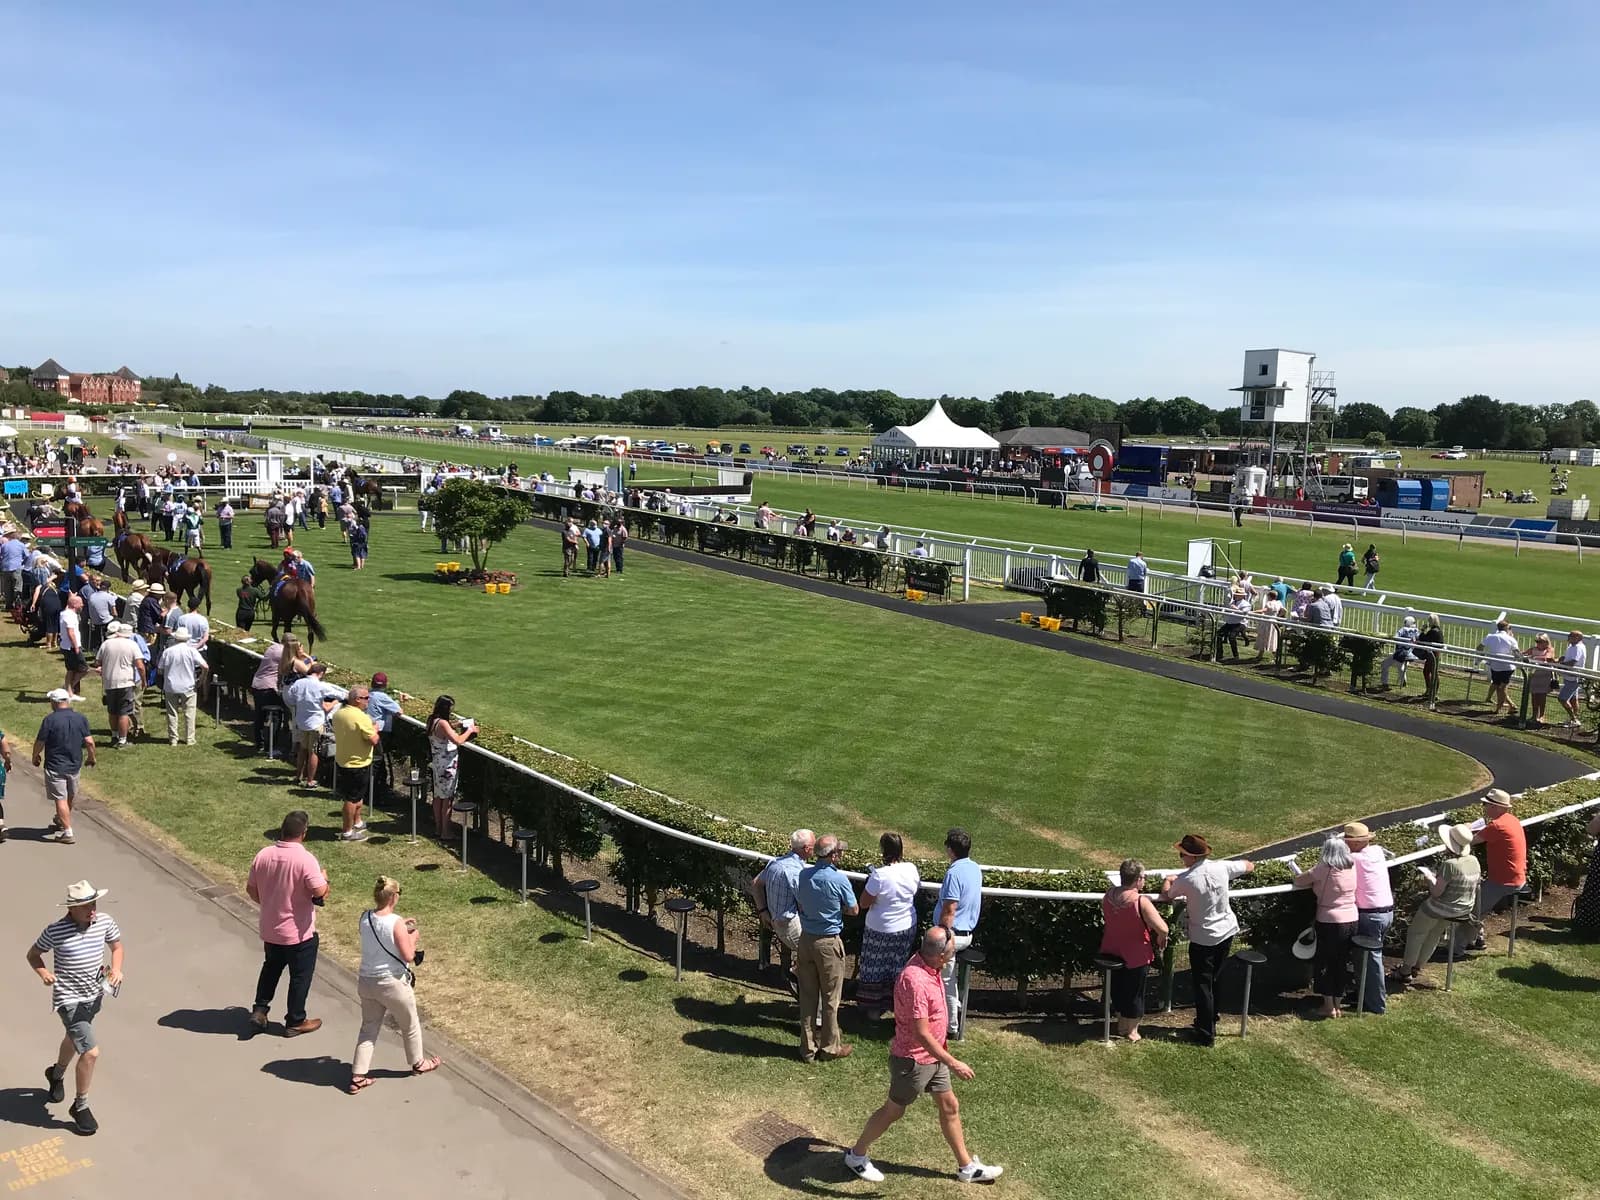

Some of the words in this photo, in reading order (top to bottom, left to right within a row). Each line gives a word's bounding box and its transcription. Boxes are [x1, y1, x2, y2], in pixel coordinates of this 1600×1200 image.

[0, 1136, 64, 1163] PLEASE
[16, 1148, 59, 1167] KEEP
[19, 1156, 68, 1176] YOUR
